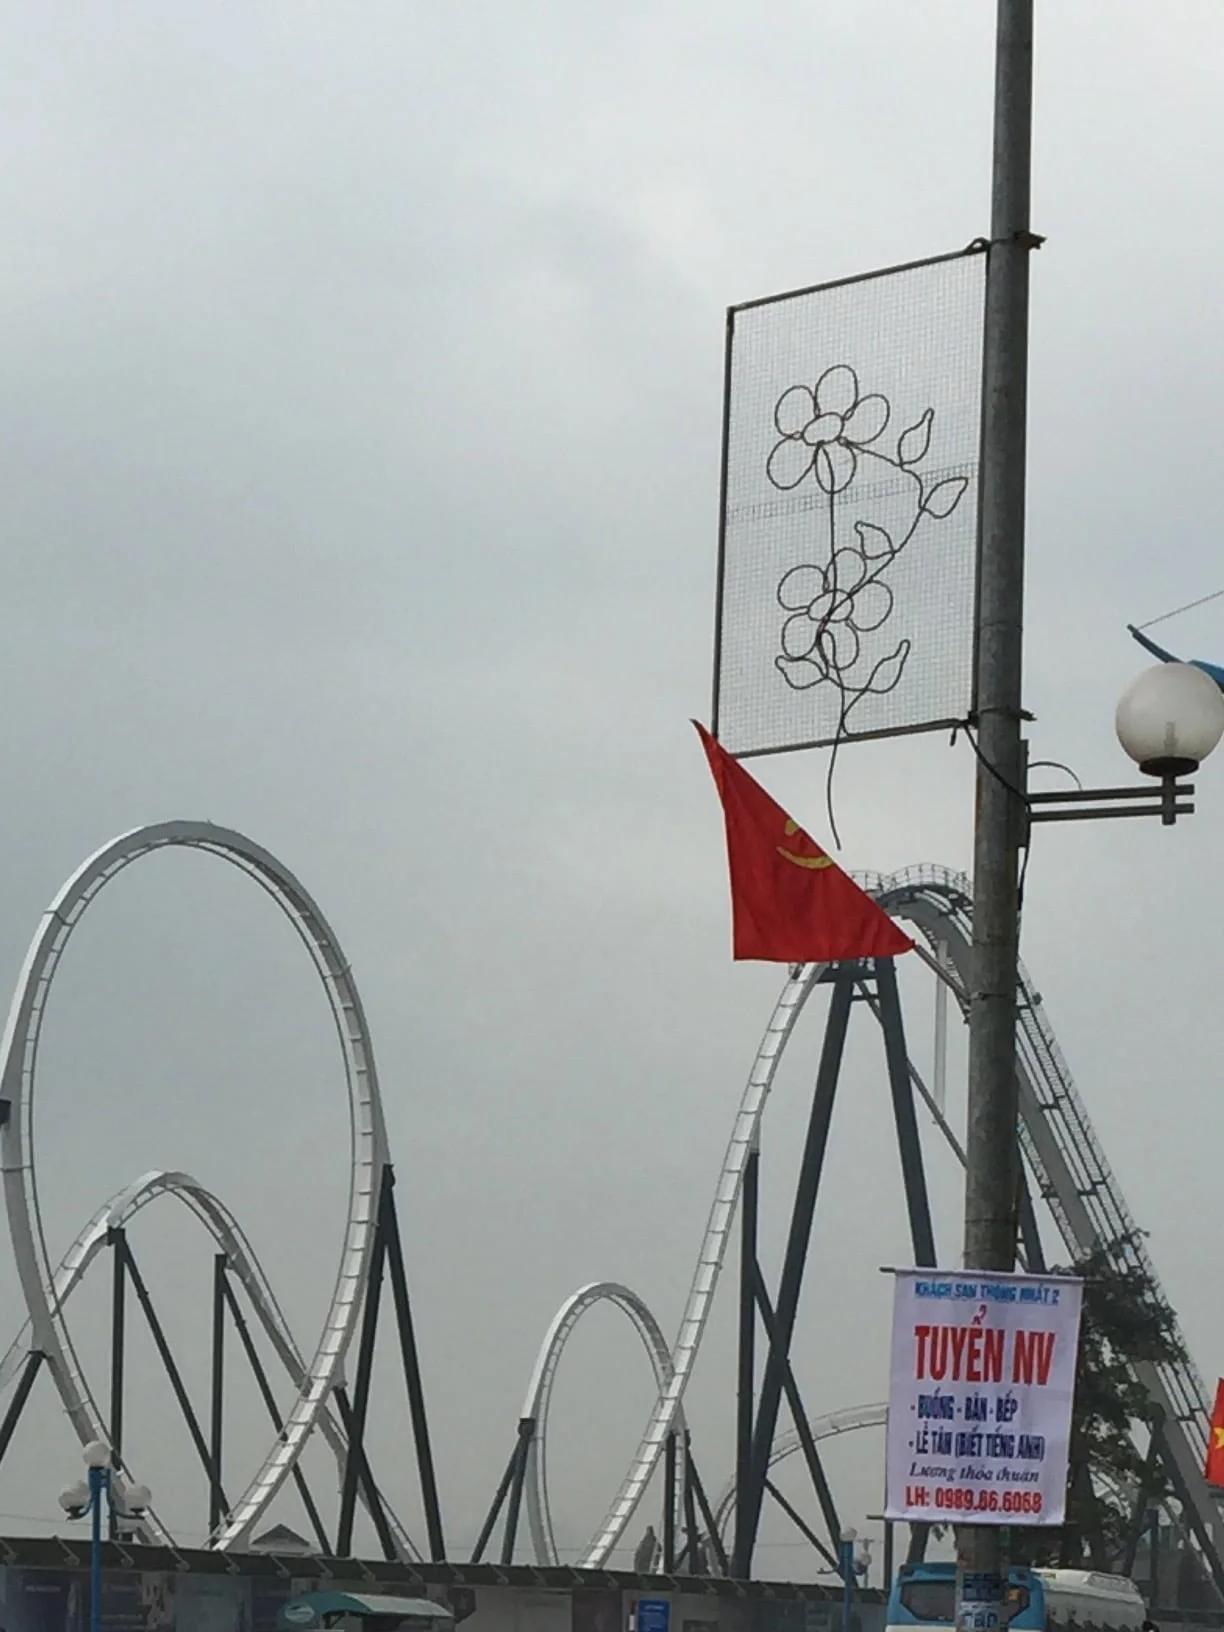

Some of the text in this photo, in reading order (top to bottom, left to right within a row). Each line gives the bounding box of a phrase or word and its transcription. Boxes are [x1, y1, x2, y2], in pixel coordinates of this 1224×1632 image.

[1051, 1288, 1060, 1305] 2
[914, 1304, 1056, 1386] TUYỂN NV
[905, 1486, 930, 1506] LH:
